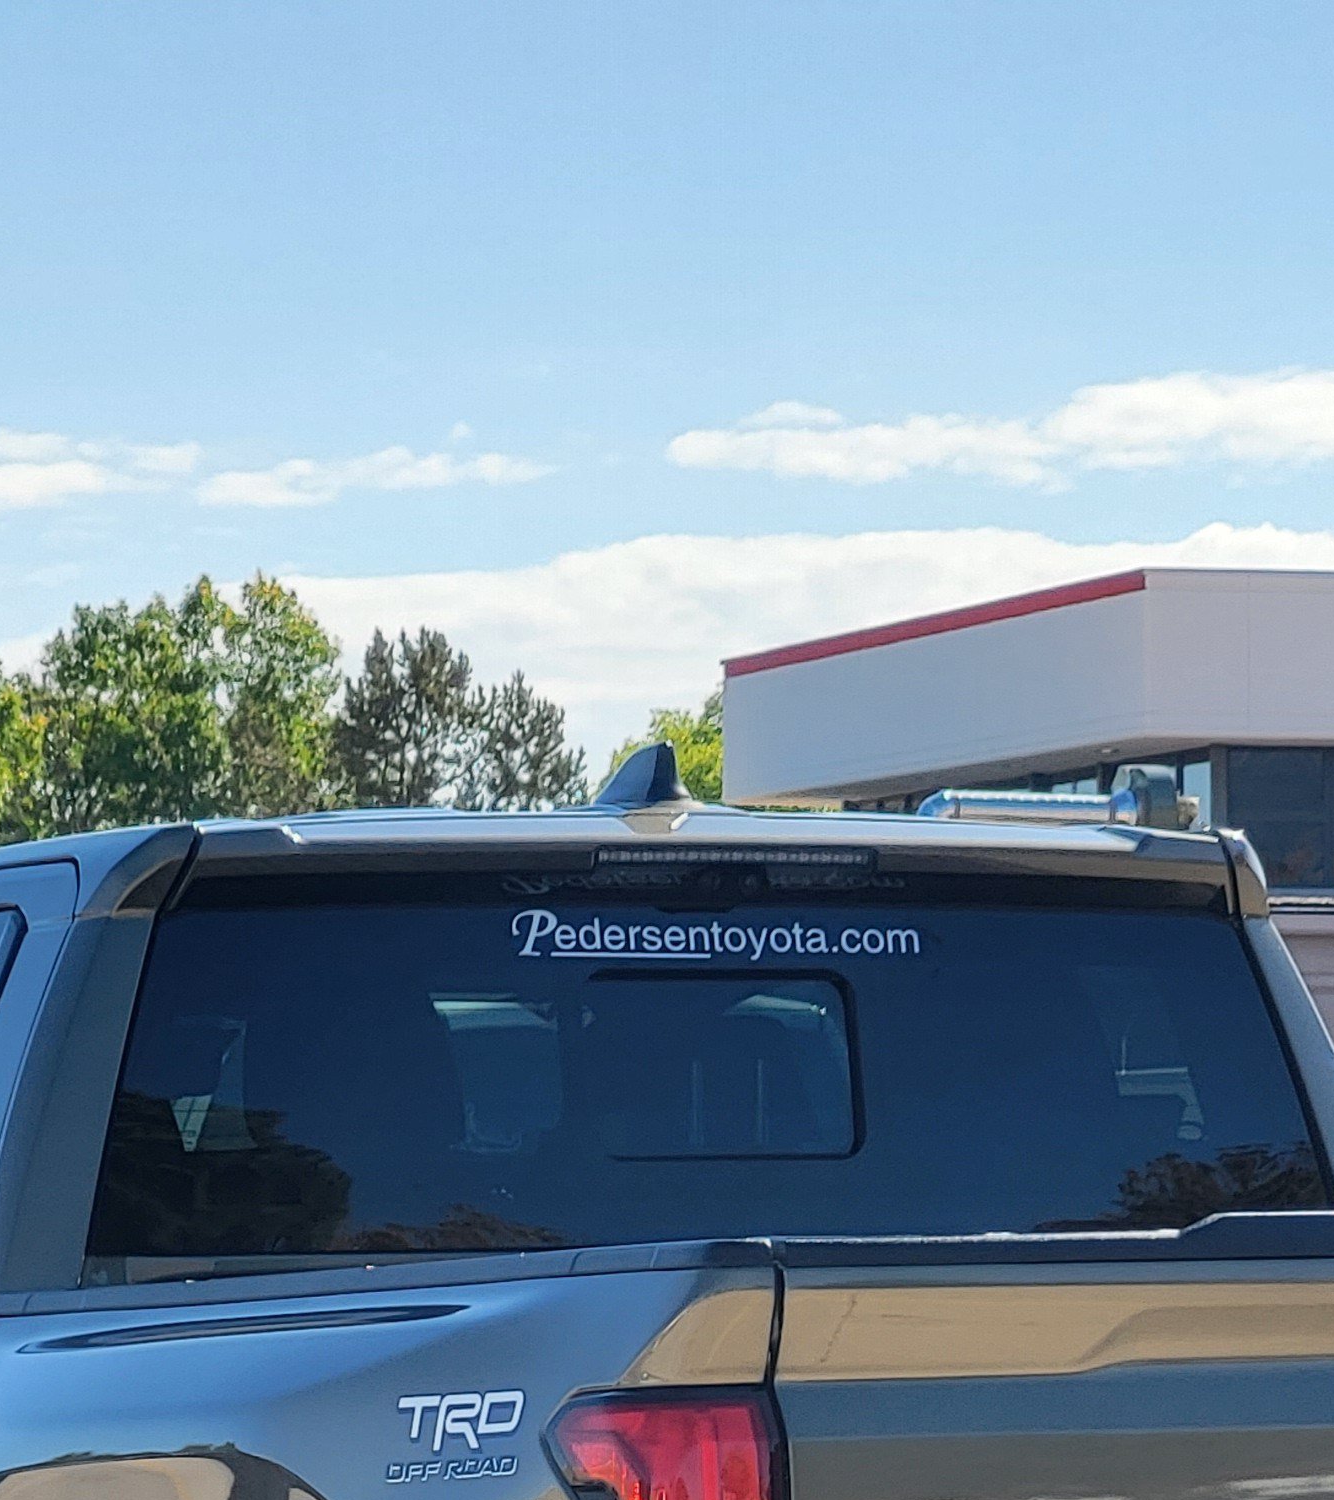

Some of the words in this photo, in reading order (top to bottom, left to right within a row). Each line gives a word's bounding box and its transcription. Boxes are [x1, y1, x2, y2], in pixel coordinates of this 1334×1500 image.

[511, 909, 920, 961] Pedersentoyota.com
[398, 1389, 525, 1451] TRD
[386, 1461, 441, 1483] OFF
[442, 1456, 518, 1480] ROAD
